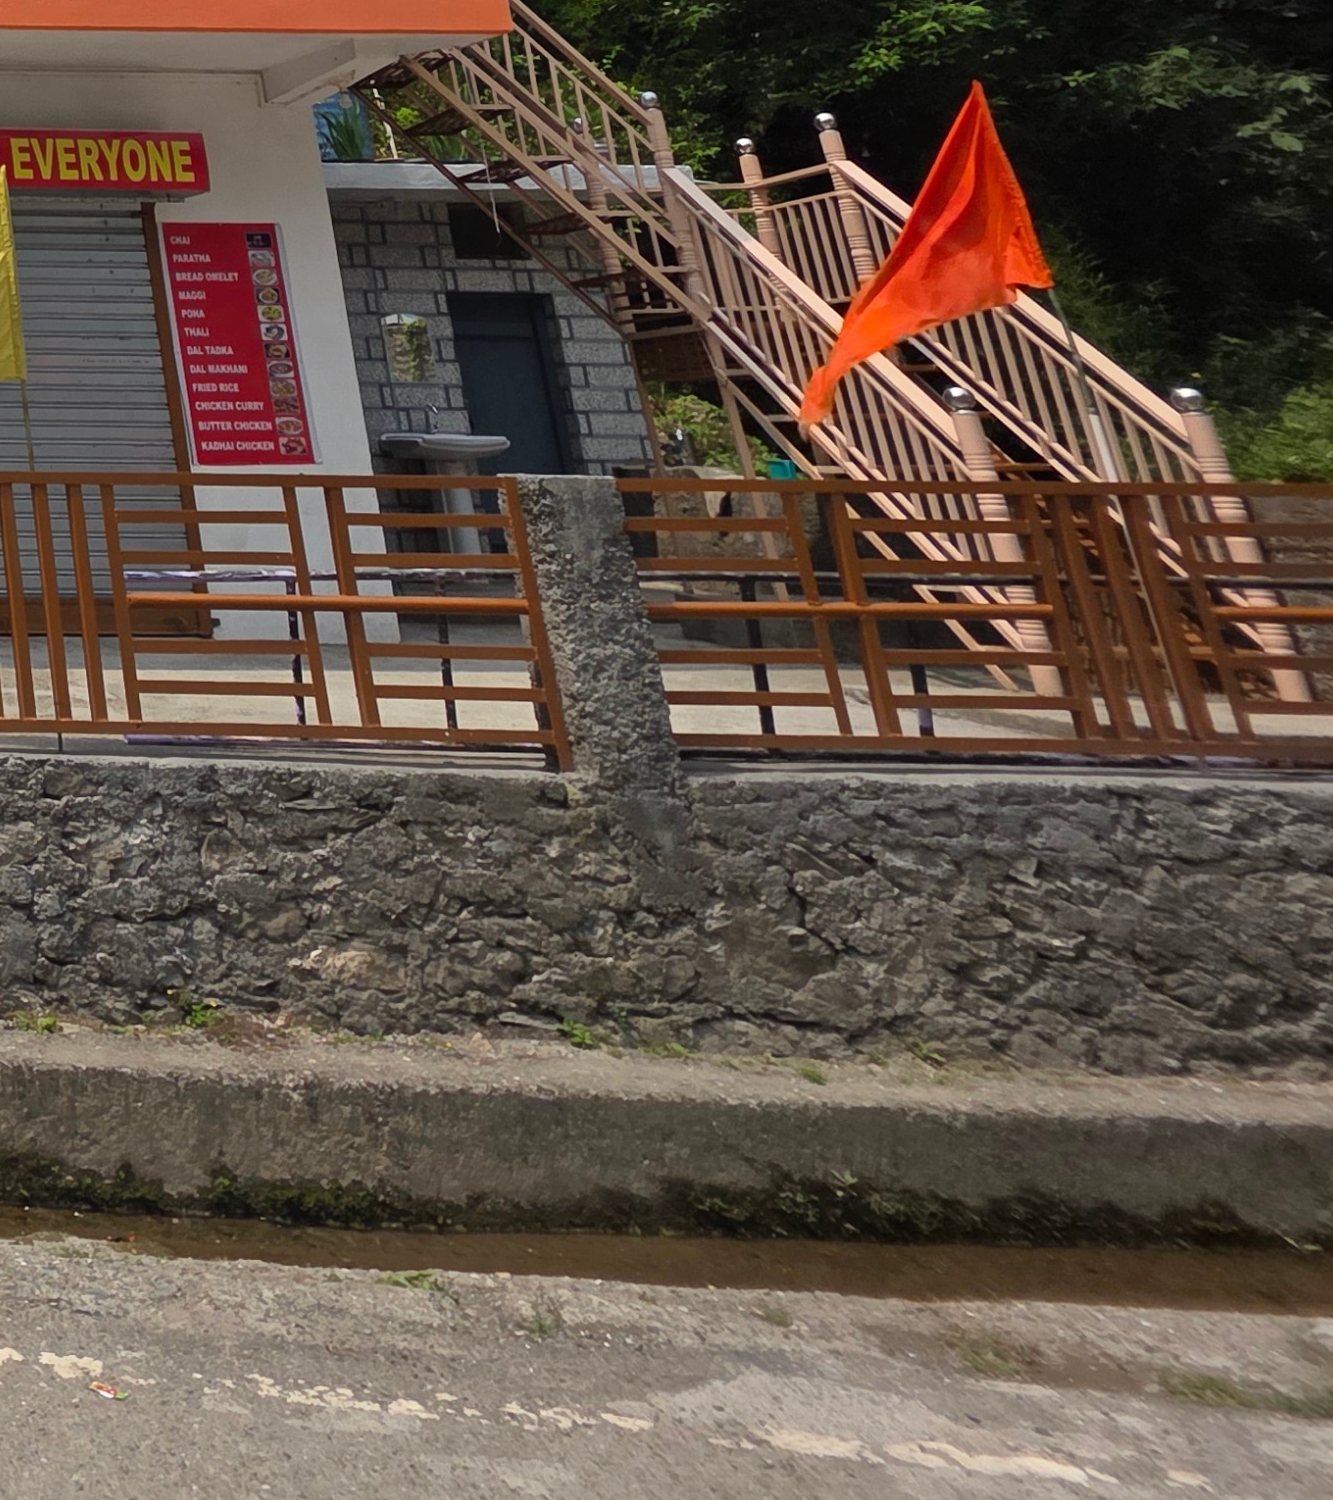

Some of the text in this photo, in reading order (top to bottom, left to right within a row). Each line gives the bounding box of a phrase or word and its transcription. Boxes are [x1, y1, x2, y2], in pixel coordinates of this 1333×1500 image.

[11, 137, 195, 182] EVERYONE
[170, 236, 190, 245] CHAI
[172, 254, 211, 263] PARATHA
[175, 272, 238, 282] BREAD OMELET
[178, 291, 206, 300] MAGGI
[181, 309, 205, 318] POHA
[184, 327, 210, 337] THALI
[187, 345, 234, 355] DAL TADKA
[190, 365, 248, 374] DAL MAKHANI
[192, 383, 239, 392] FRIED RICE
[195, 401, 264, 411] CHICKEN CURRY
[198, 421, 272, 430] BUTTER CHICKEN
[201, 441, 275, 450] KADHAI CHICKEN
